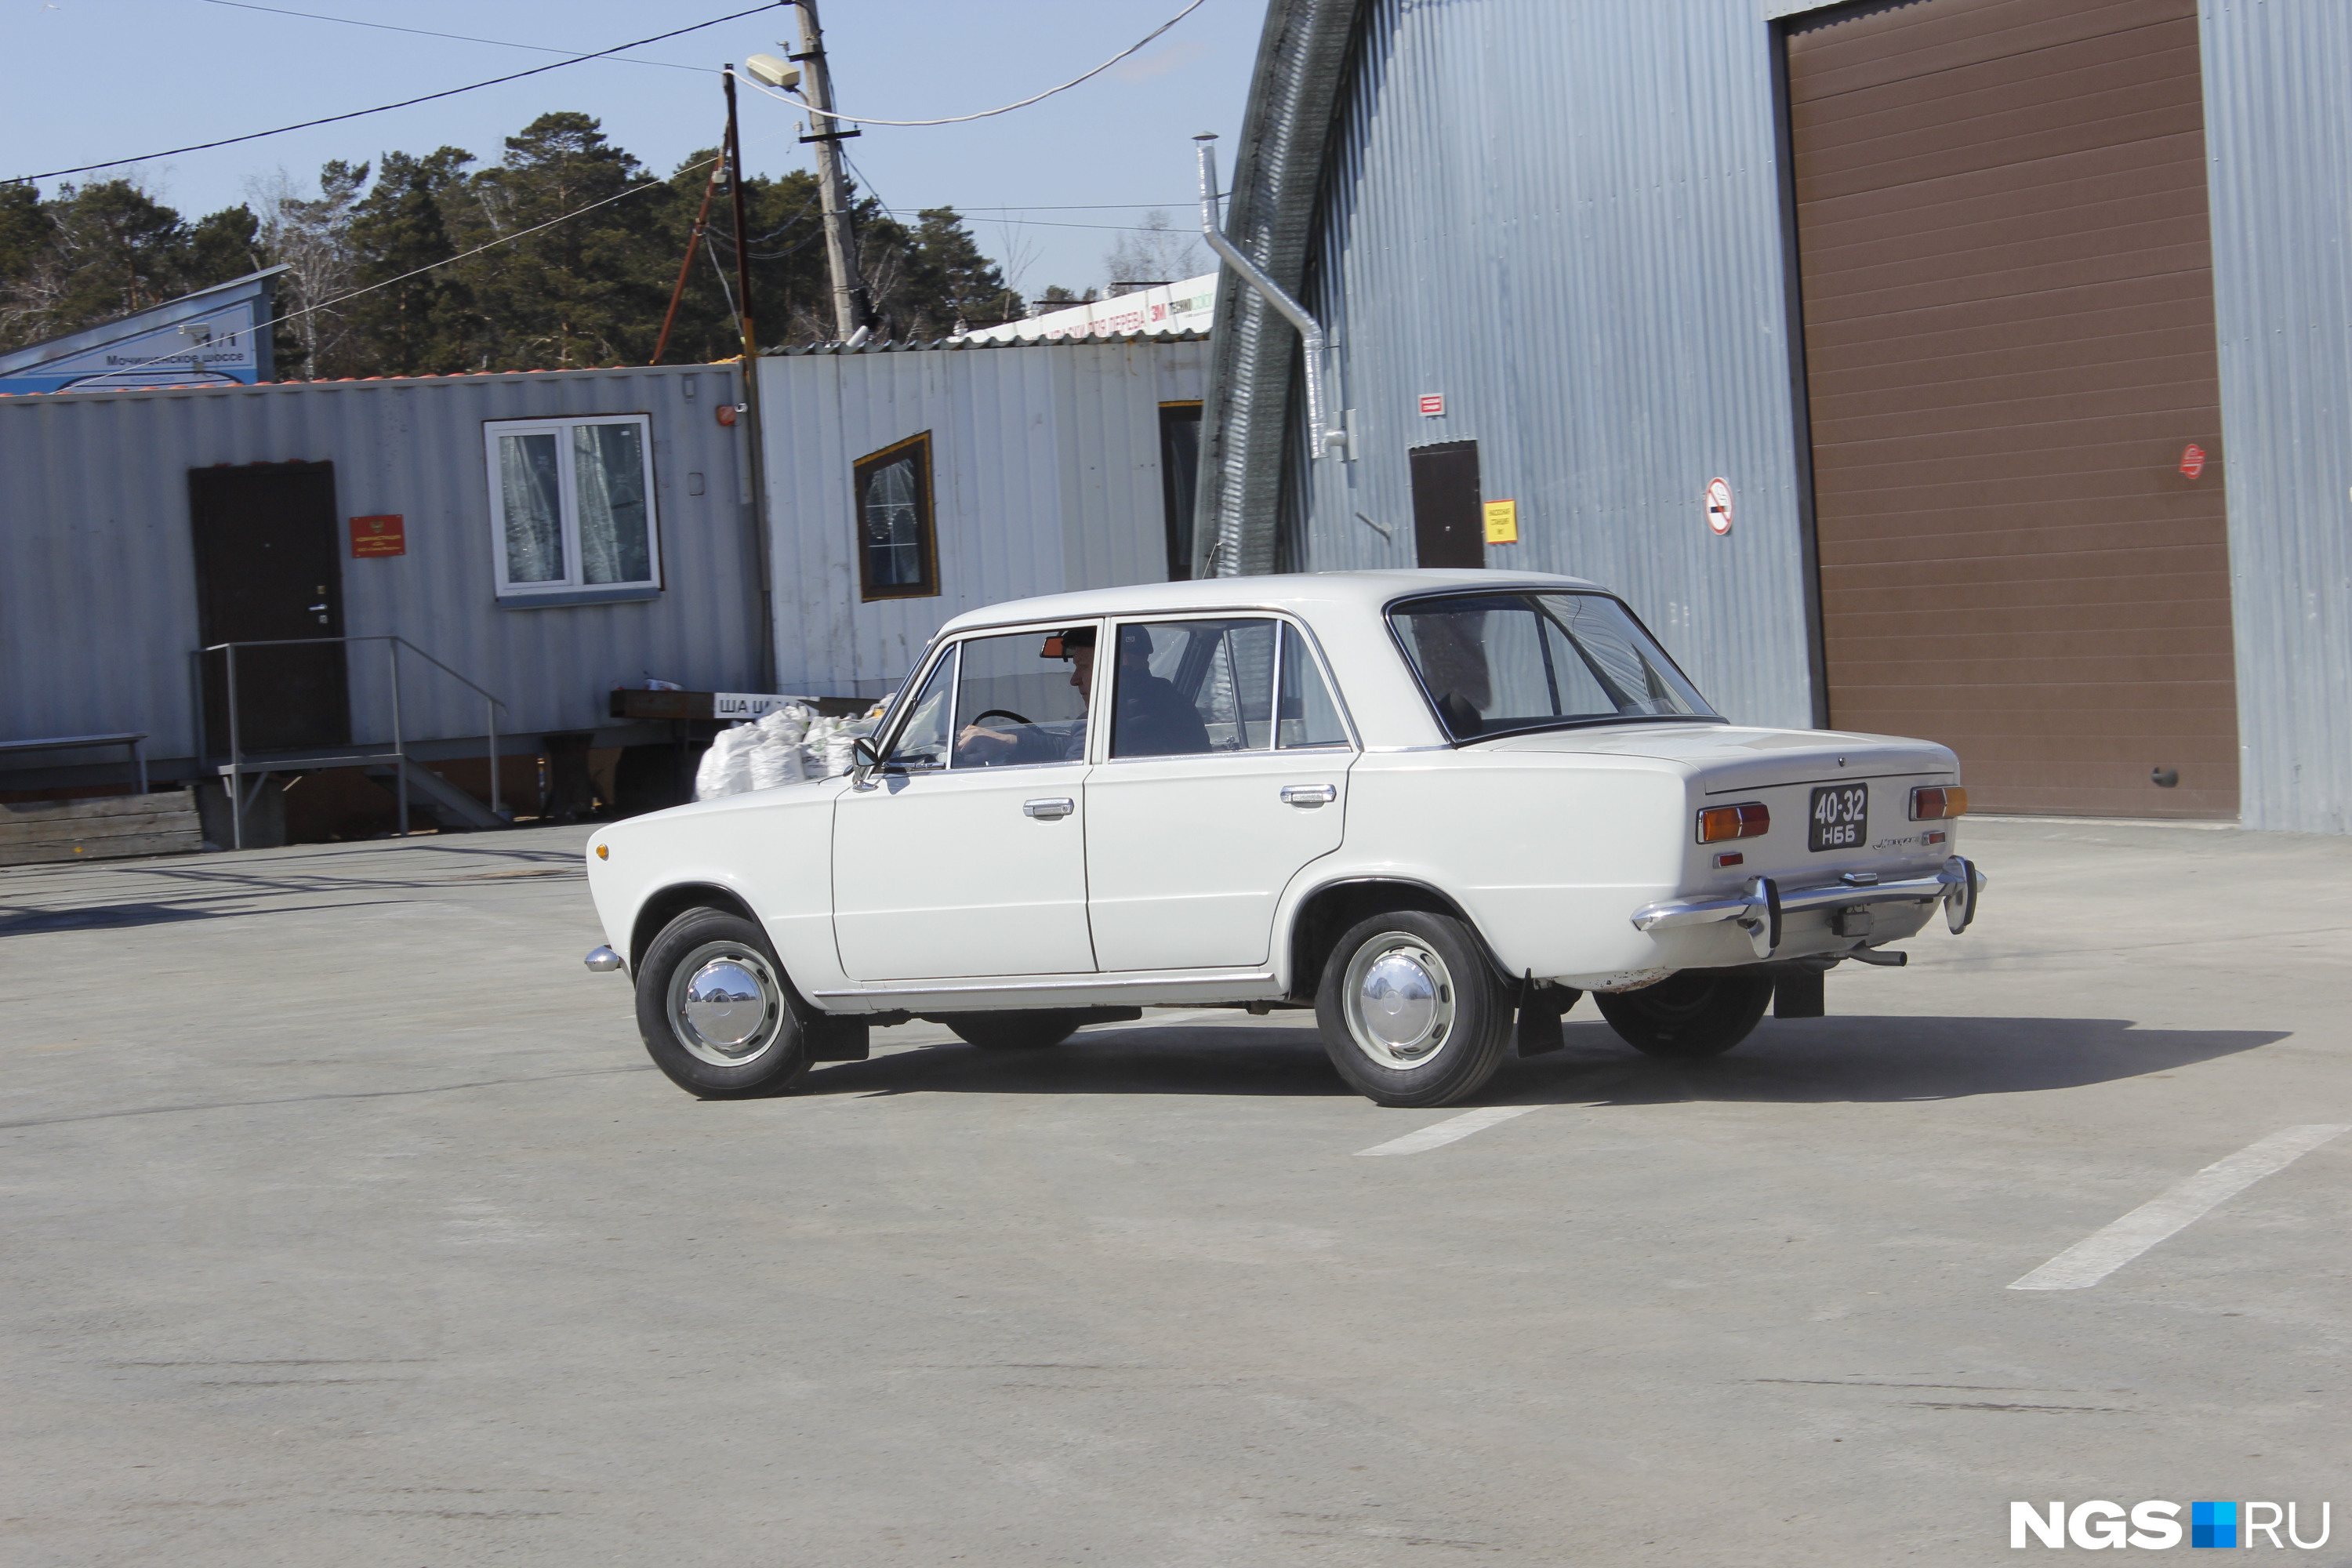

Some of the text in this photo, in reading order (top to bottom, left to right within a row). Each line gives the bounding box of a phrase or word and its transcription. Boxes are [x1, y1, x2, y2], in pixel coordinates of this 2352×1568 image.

[1151, 303, 1167, 322] 3M
[107, 351, 245, 367] Мочищенское шоссе
[1822, 824, 1855, 845] НББ
